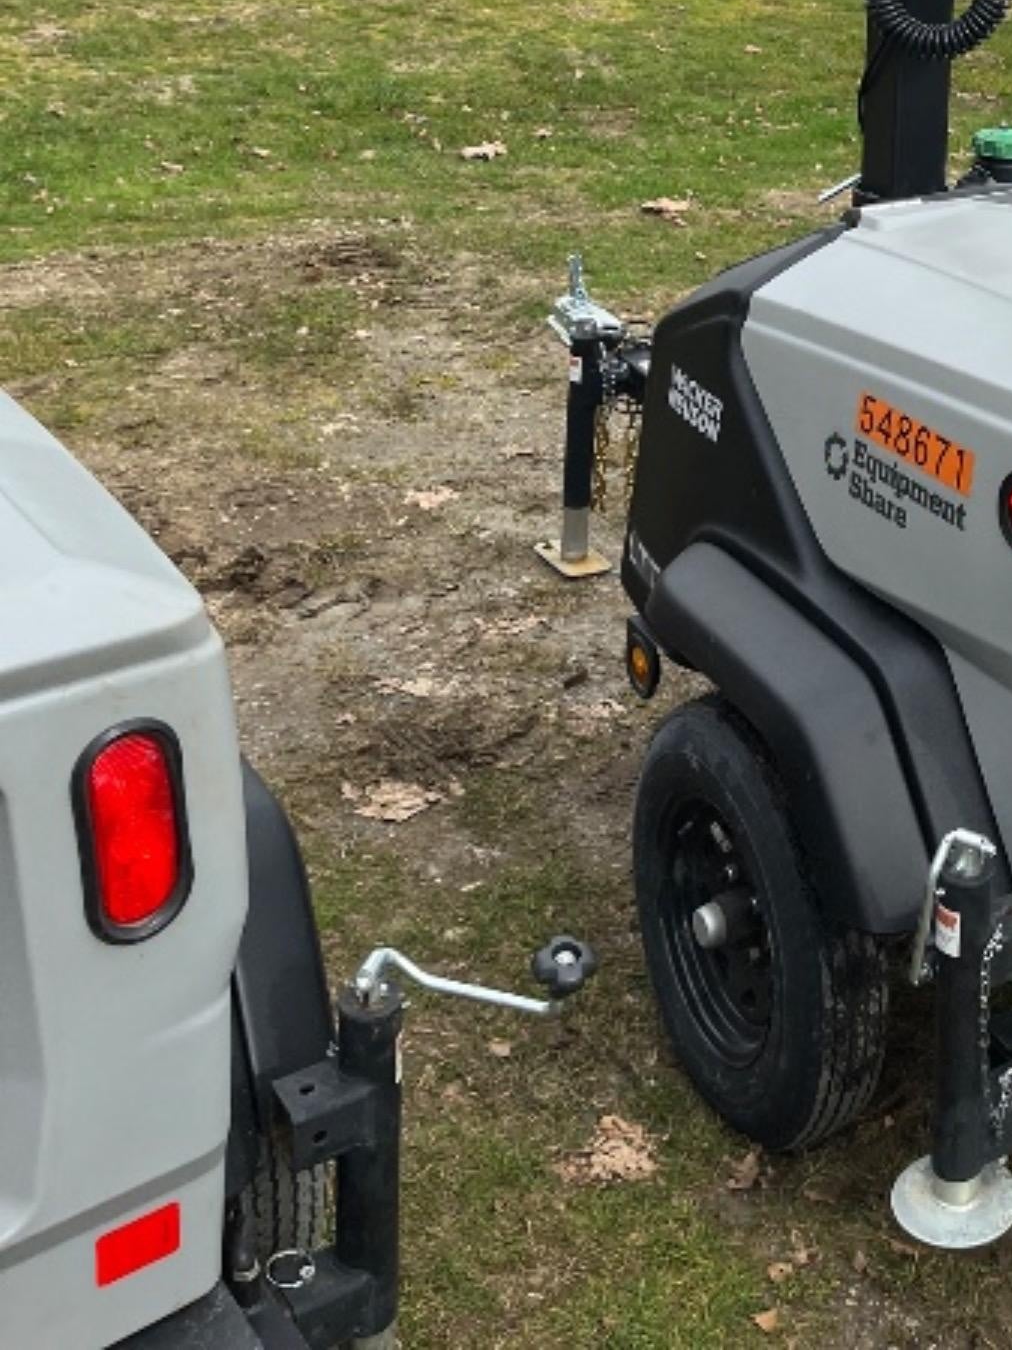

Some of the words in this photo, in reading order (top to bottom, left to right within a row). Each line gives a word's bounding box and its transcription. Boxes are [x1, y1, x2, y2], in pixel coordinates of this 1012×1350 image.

[852, 437, 966, 531] Equipment
[860, 395, 965, 490] 548671
[849, 470, 907, 528] Share
